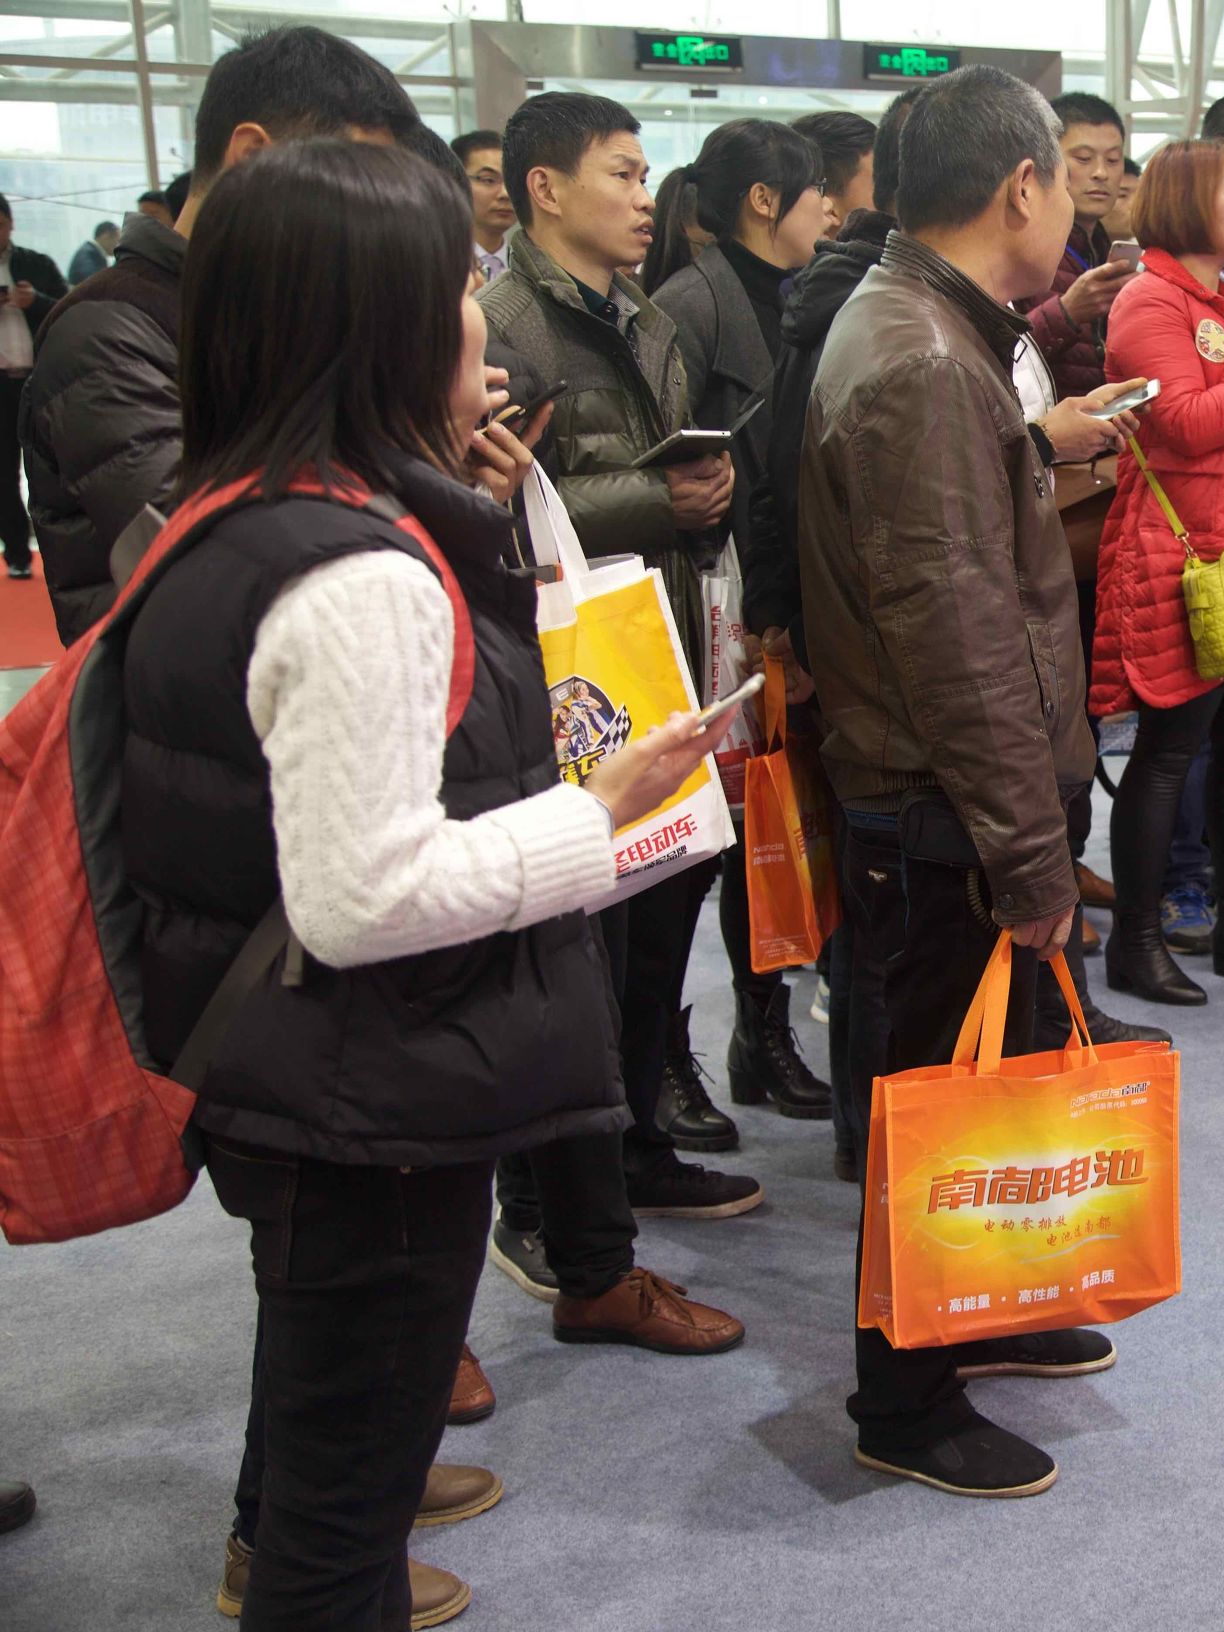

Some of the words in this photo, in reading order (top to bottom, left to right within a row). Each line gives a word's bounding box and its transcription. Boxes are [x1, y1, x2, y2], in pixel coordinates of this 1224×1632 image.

[927, 1148, 1150, 1215] 南都电池
[948, 1293, 991, 1314] 高能量
[1018, 1284, 1061, 1305] 高性能
